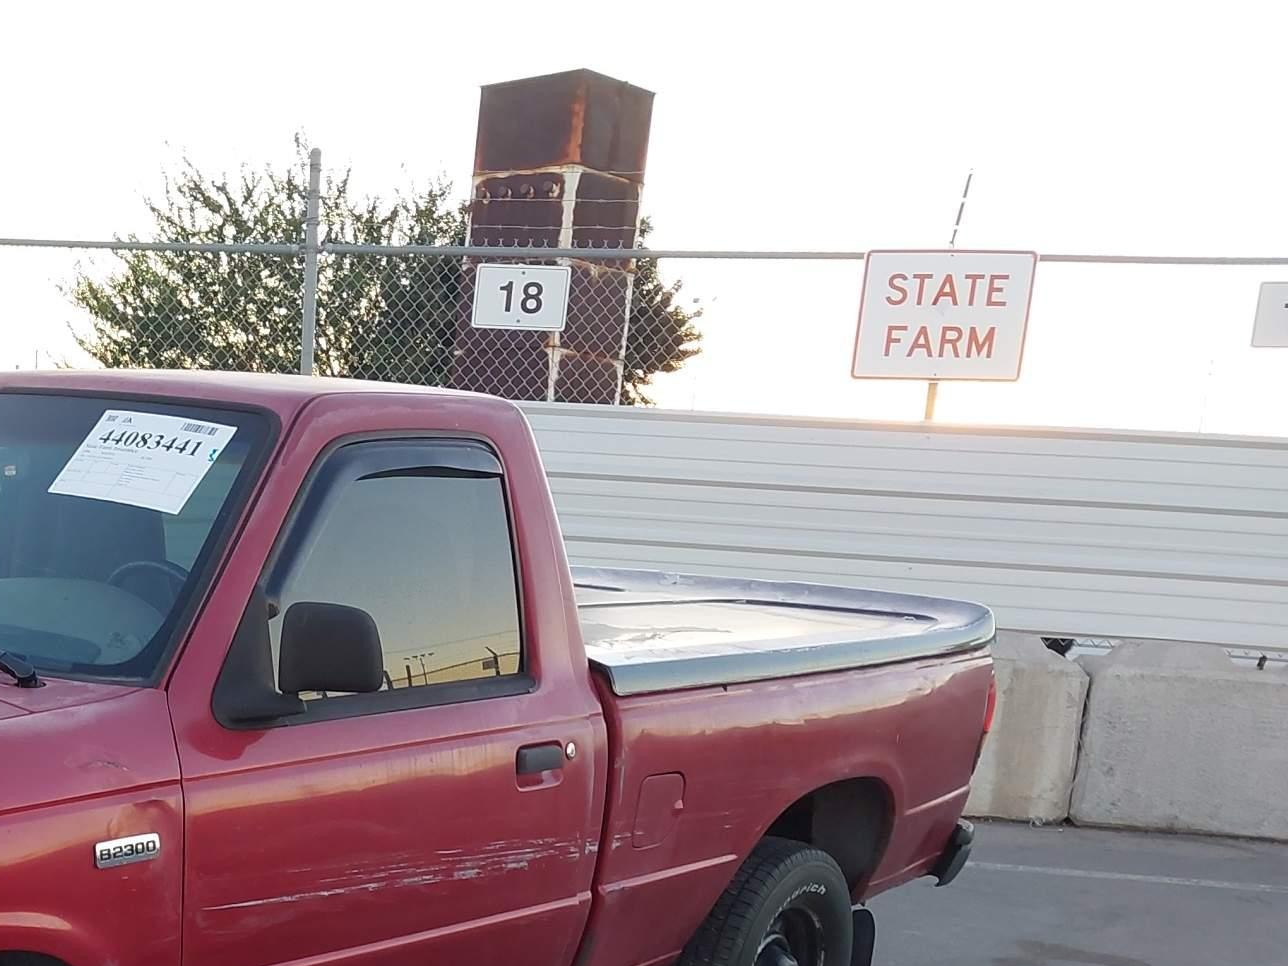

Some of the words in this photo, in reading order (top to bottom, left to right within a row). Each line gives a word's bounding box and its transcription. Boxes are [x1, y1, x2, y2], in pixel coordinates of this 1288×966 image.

[499, 280, 544, 314] 18
[885, 273, 1010, 307] STATE
[883, 325, 996, 359] FARM
[99, 428, 203, 457] 44083441
[99, 840, 157, 862] B2300
